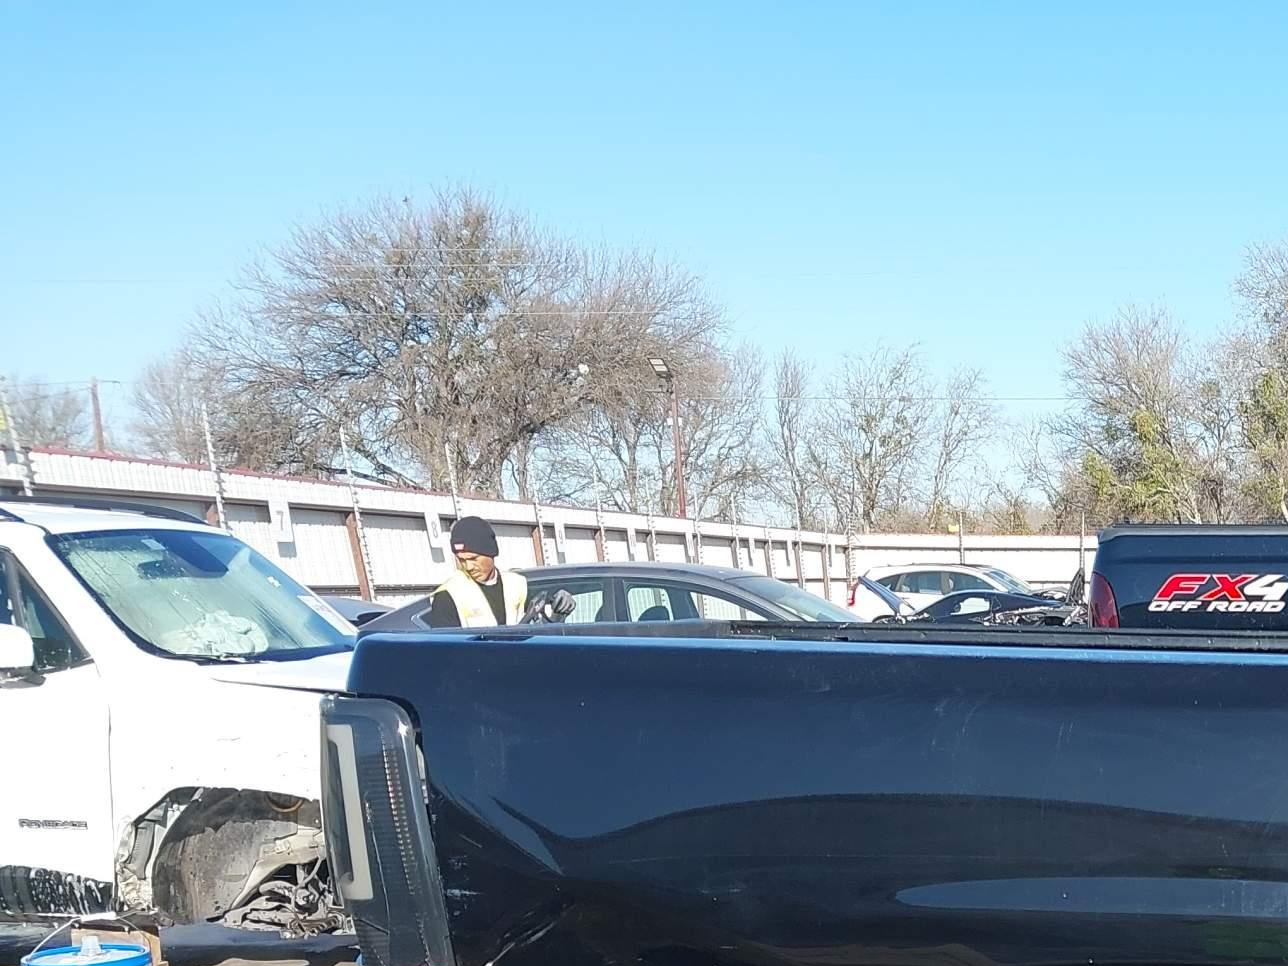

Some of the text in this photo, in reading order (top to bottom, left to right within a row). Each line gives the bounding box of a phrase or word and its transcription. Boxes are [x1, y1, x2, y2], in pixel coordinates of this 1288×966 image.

[430, 520, 439, 539] 8
[1147, 600, 1287, 613] OFF ROAD
